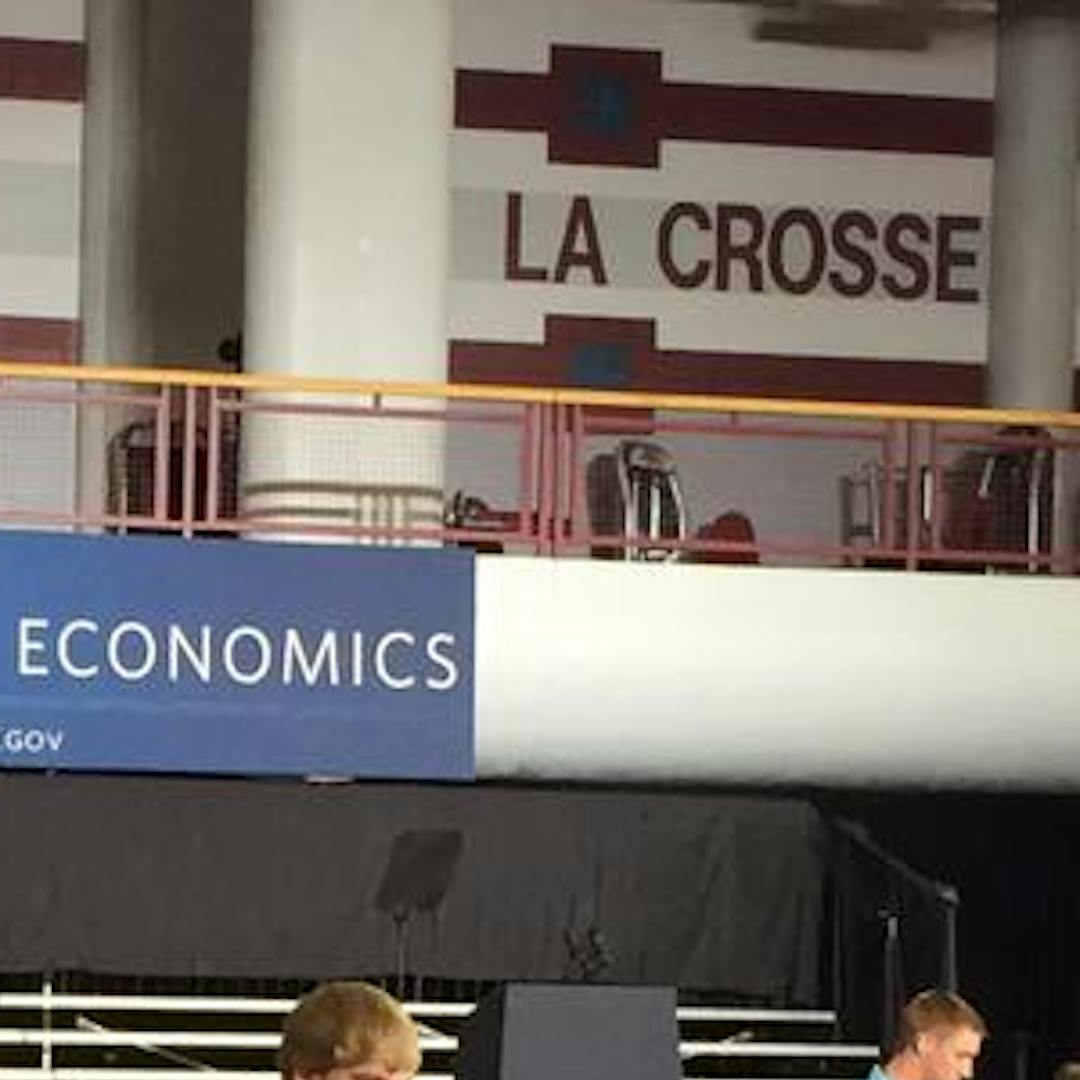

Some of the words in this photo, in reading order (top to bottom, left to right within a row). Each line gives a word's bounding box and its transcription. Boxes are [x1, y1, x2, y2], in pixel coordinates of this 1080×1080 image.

[504, 192, 608, 285] LA
[657, 201, 983, 304] CROSSE
[16, 617, 458, 691] ECONOMICS
